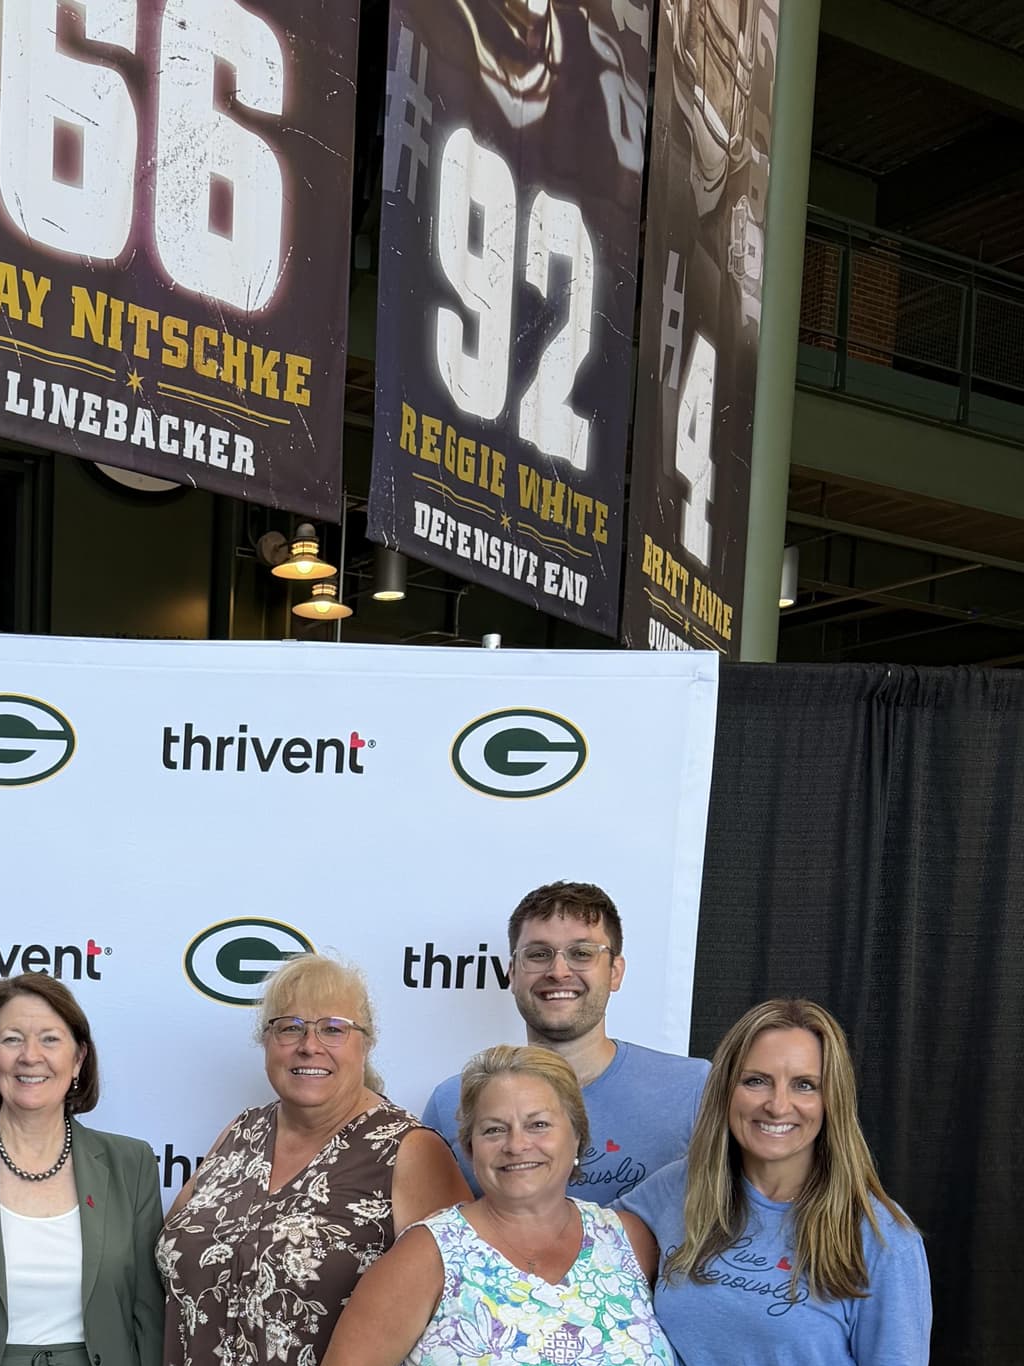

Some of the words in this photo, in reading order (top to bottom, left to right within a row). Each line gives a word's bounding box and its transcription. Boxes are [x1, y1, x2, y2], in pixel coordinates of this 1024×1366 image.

[71, 286, 312, 407] NITSCHKE
[5, 370, 256, 476] LINEBACKER
[399, 402, 507, 499] REGGIE
[518, 464, 609, 545] WHITE
[413, 501, 539, 588] DEFENSIVE
[543, 562, 588, 607] END
[641, 534, 689, 606] BRETT
[691, 577, 733, 640] FAVRE
